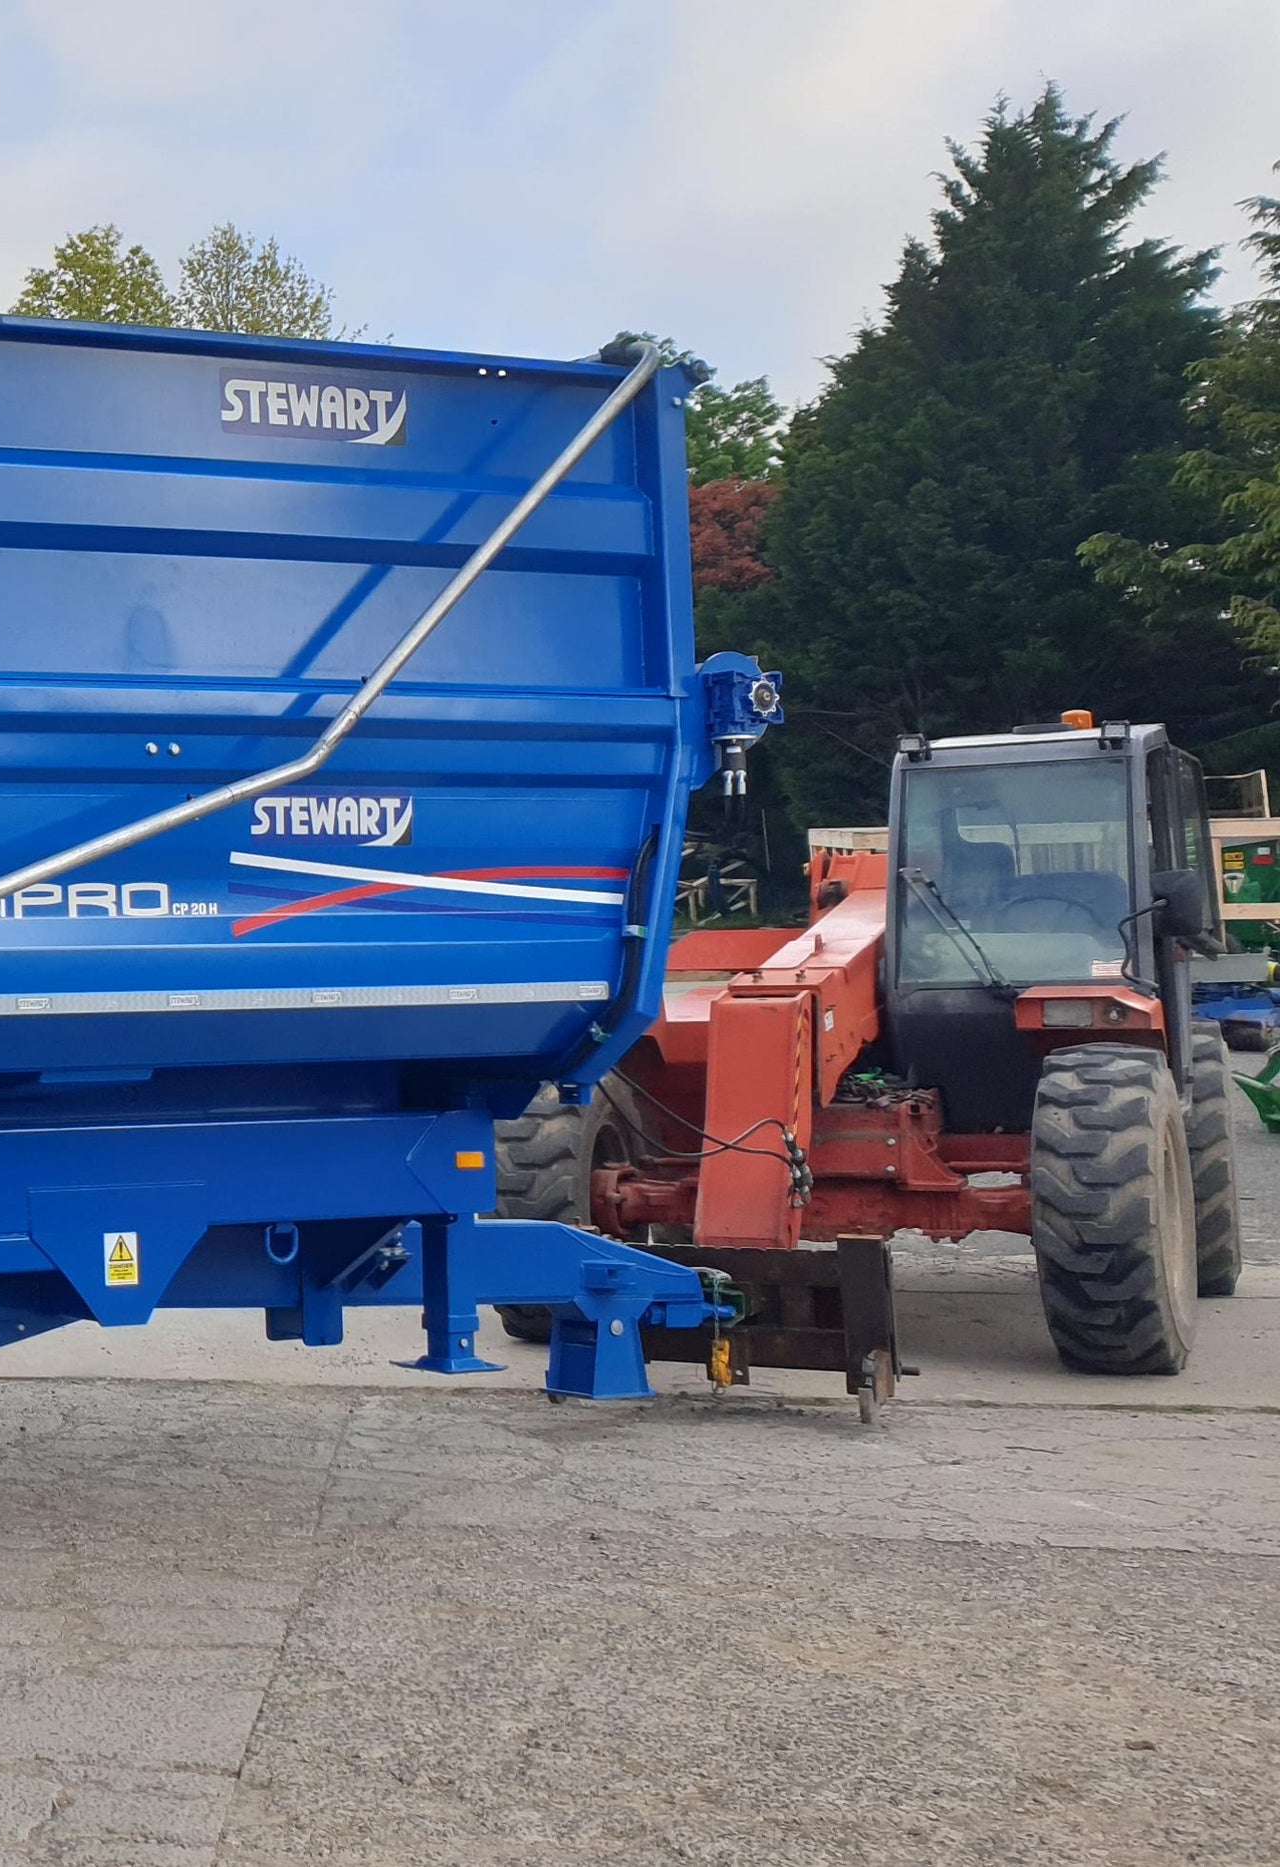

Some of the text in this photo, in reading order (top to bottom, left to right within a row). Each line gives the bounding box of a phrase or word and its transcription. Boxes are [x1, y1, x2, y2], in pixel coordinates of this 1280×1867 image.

[221, 379, 407, 445] STEWART
[251, 796, 413, 846] STEWART
[13, 882, 169, 919] PRO
[172, 902, 189, 915] CP
[190, 902, 207, 915] 20
[208, 902, 218, 915] H
